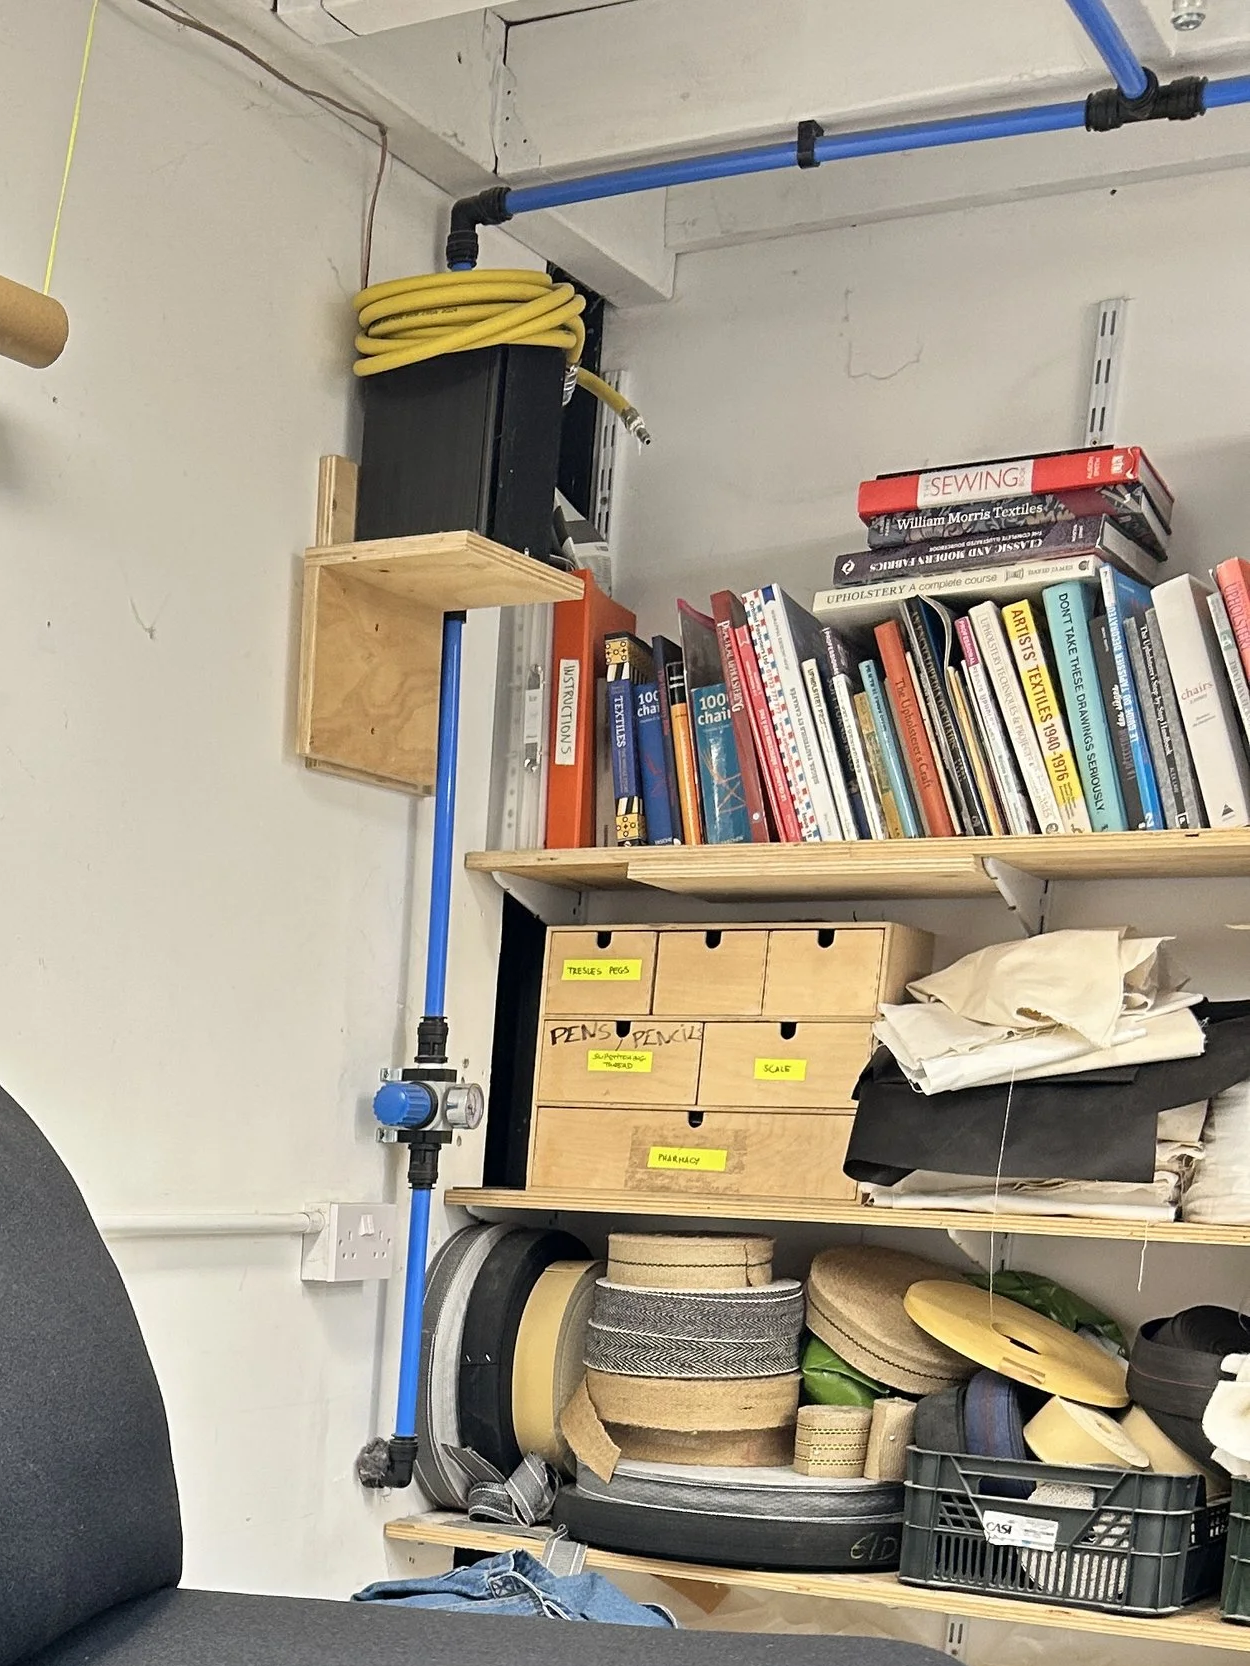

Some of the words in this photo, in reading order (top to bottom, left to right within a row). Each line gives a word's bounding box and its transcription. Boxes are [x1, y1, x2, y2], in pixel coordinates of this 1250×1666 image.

[931, 467, 1017, 496] SEWING
[897, 511, 945, 530] William
[949, 507, 991, 524] Morris
[993, 502, 1043, 519] Textiles
[994, 536, 1043, 553] CLASSIC
[1000, 531, 1031, 541] COMPLETE
[868, 556, 916, 573] FABRICS
[916, 549, 964, 565] MODERN
[967, 544, 993, 557] AND
[825, 584, 905, 605] UPHOLSTERY
[907, 582, 915, 592] A
[917, 576, 962, 592] complete
[964, 572, 997, 585] course
[748, 599, 759, 622] Orbital
[754, 623, 767, 654] Fasteners
[761, 654, 770, 665] Ltd
[1064, 626, 1077, 655] TAKE
[979, 616, 1003, 665] UPHOLSTERY
[994, 666, 1020, 718] TECHNIQUES
[1069, 656, 1084, 692] THESE
[1114, 652, 1129, 692] TAPISSIER
[894, 677, 908, 698] The
[1139, 624, 1149, 639] The
[1159, 721, 1174, 755] Handbook
[1181, 681, 1213, 700] chairs
[560, 665, 575, 755] INSTRUCTIONS
[614, 694, 625, 747] TEXTILES
[1026, 664, 1053, 723] TEXTILES
[1042, 722, 1068, 781] 1940-1976
[1075, 693, 1094, 751] DRAWINGS
[899, 698, 923, 762] Upholsterer's
[917, 762, 933, 789] Craft
[609, 966, 630, 975] PEGS
[632, 1023, 703, 1048] PENCILS
[763, 1065, 791, 1073] SCALE
[658, 1154, 700, 1165] PHARMACY
